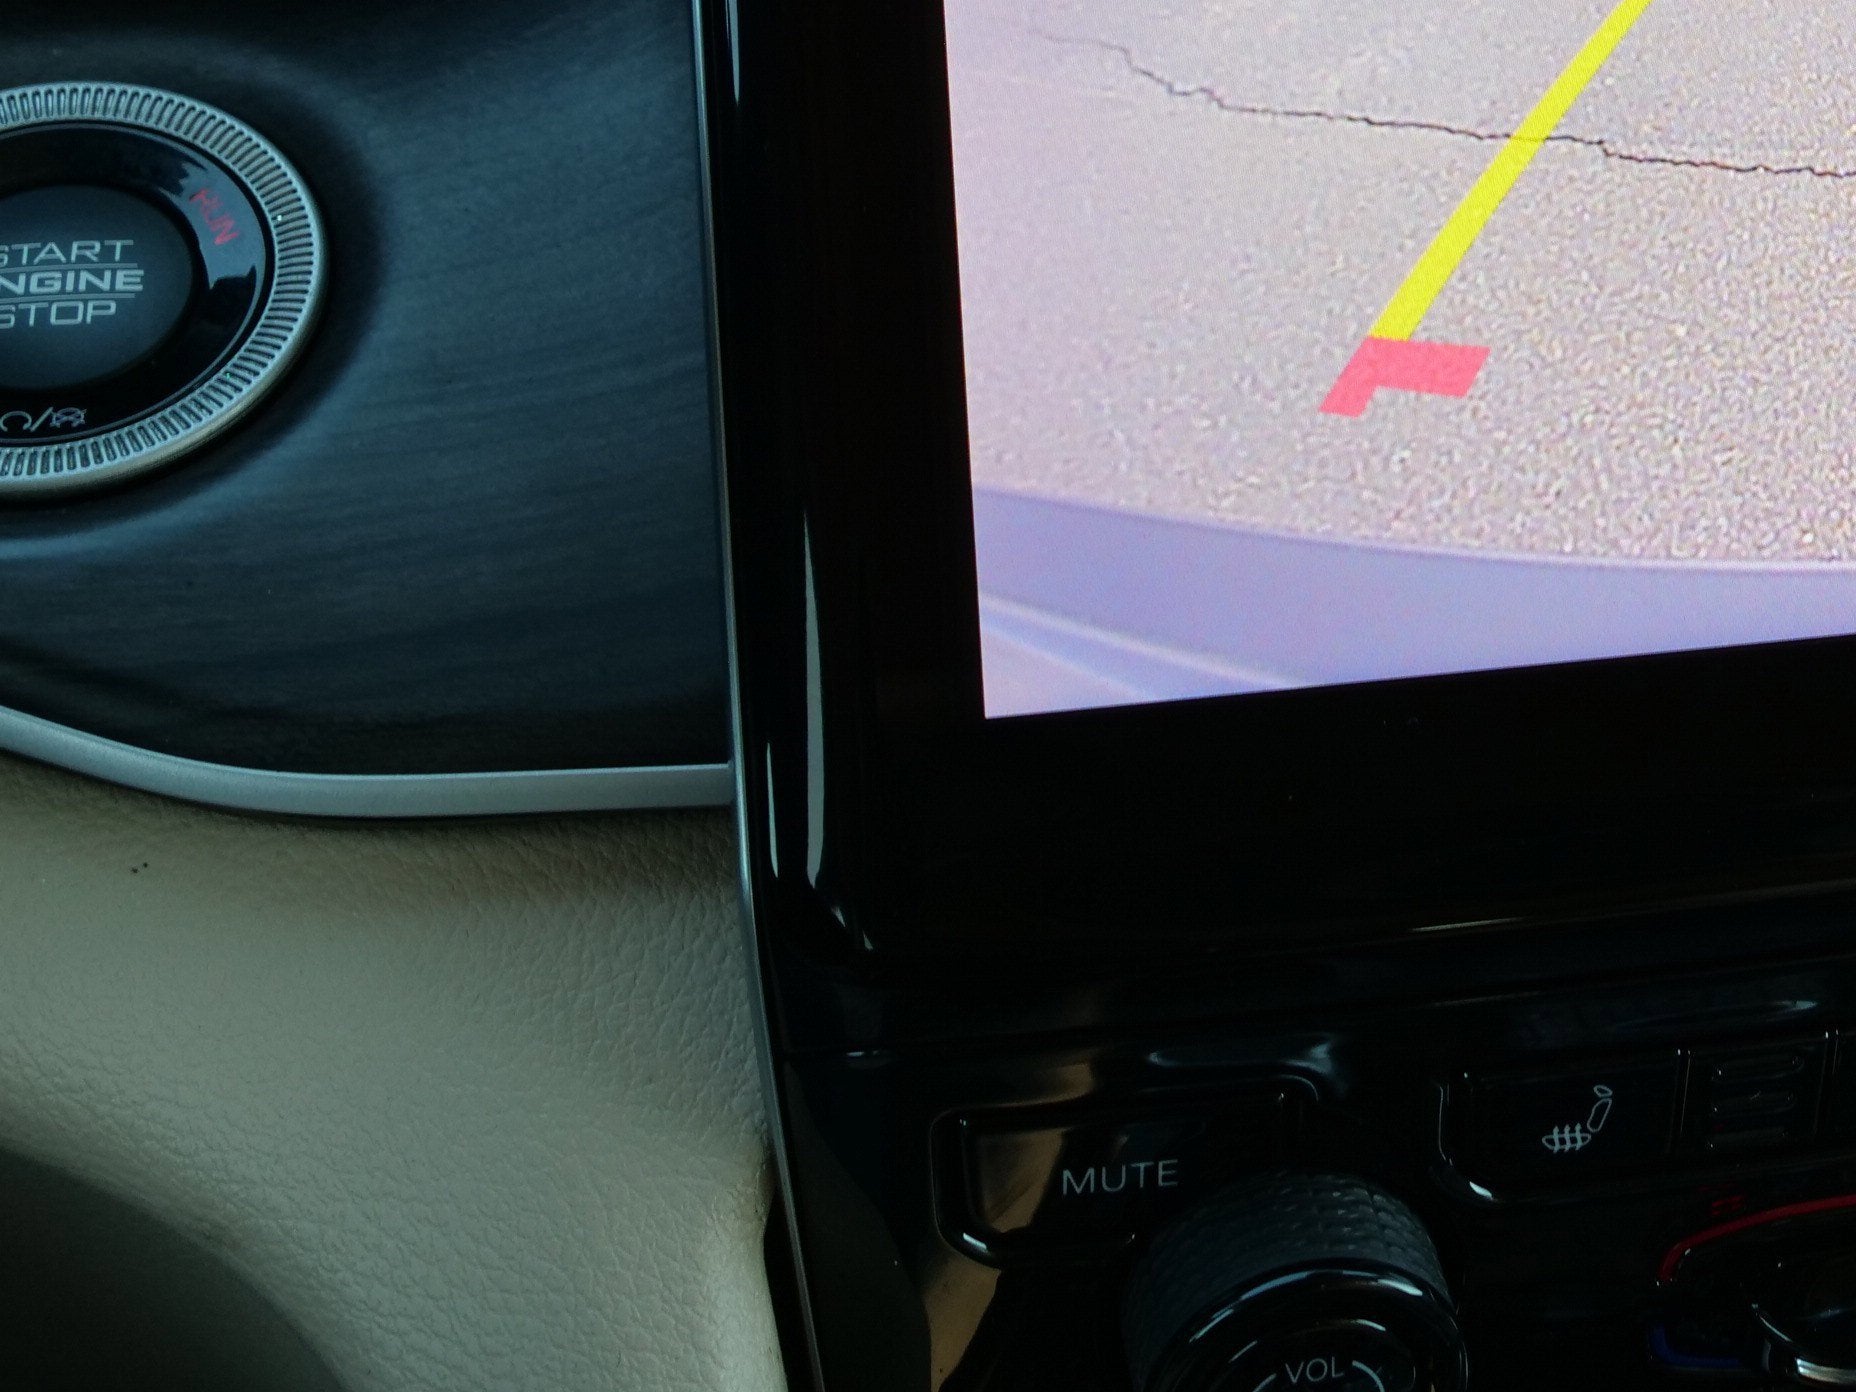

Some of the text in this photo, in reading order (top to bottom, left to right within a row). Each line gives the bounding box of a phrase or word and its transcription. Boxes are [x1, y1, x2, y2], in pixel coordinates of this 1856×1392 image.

[0, 268, 145, 296] NGINE
[1062, 1158, 1180, 1196] MUTE
[1285, 1355, 1345, 1384] VOL
